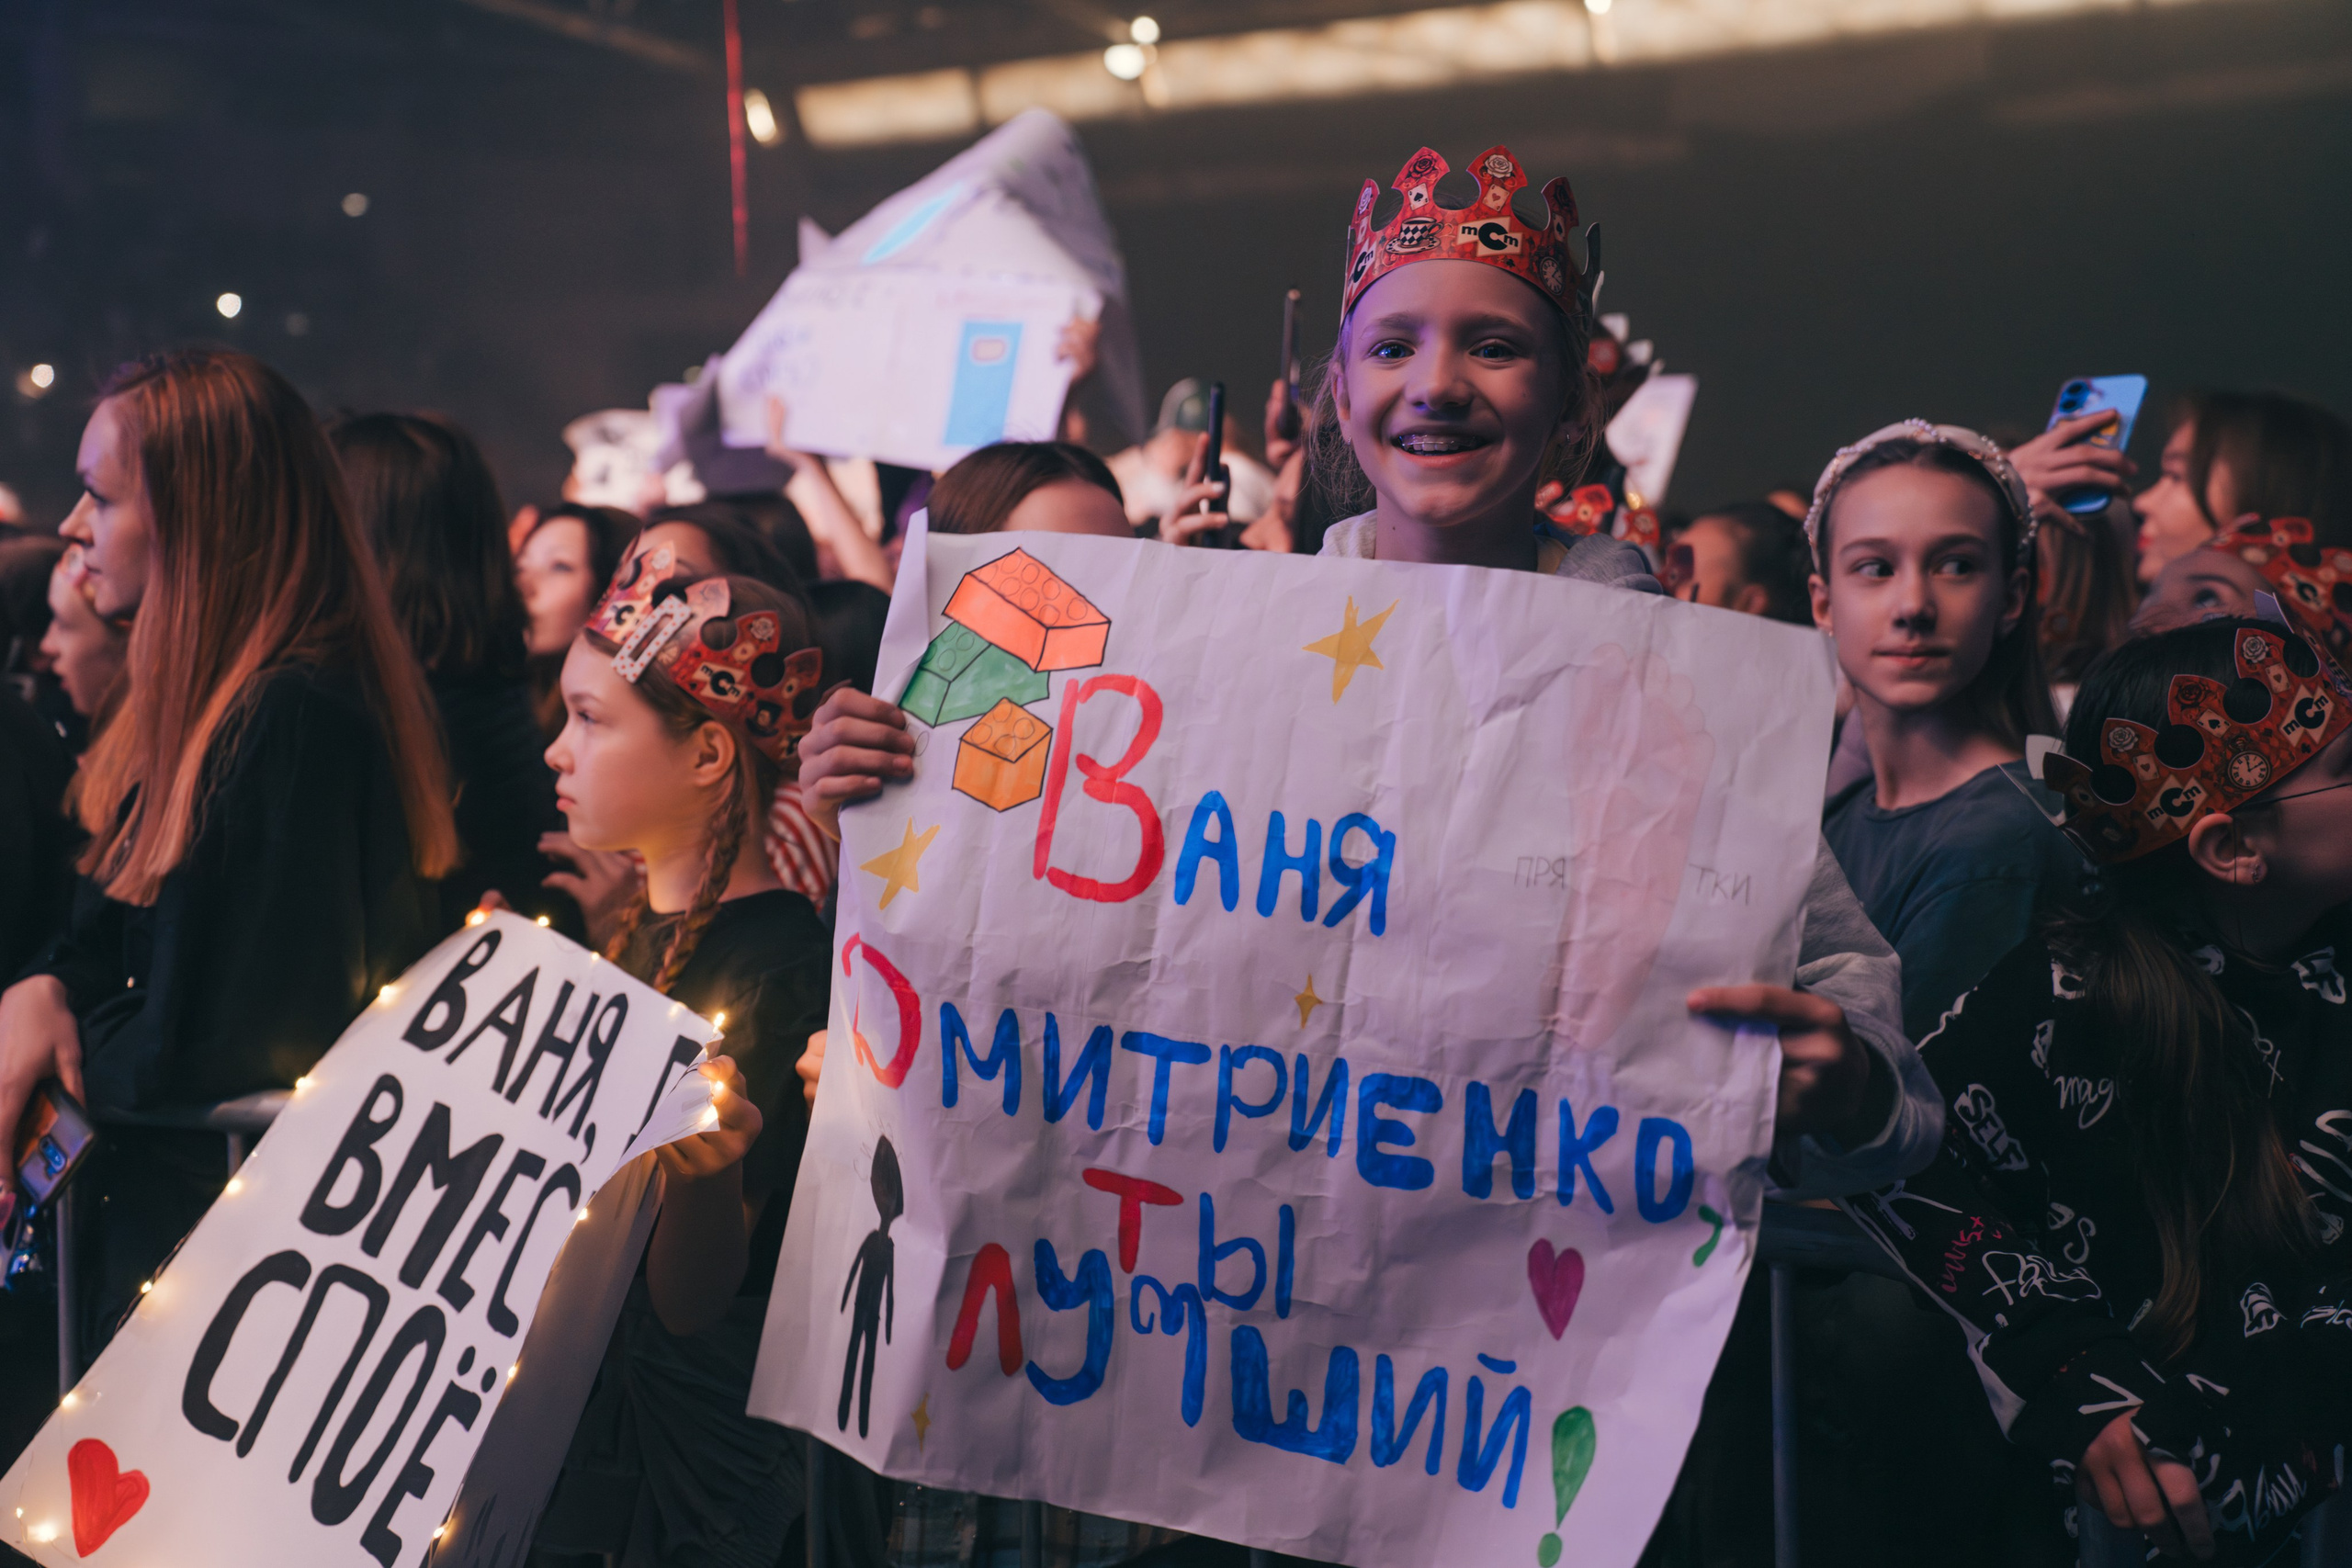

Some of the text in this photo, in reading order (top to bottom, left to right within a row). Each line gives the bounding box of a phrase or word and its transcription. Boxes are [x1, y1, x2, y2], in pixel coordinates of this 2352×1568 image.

[1033, 673, 1397, 937] ВАНЯ
[401, 929, 628, 1165] ВАНЯ,
[299, 1073, 582, 1338] ВМЕС
[1082, 1168, 1295, 1319] ТЫ
[182, 1250, 497, 1568] СПОЁ
